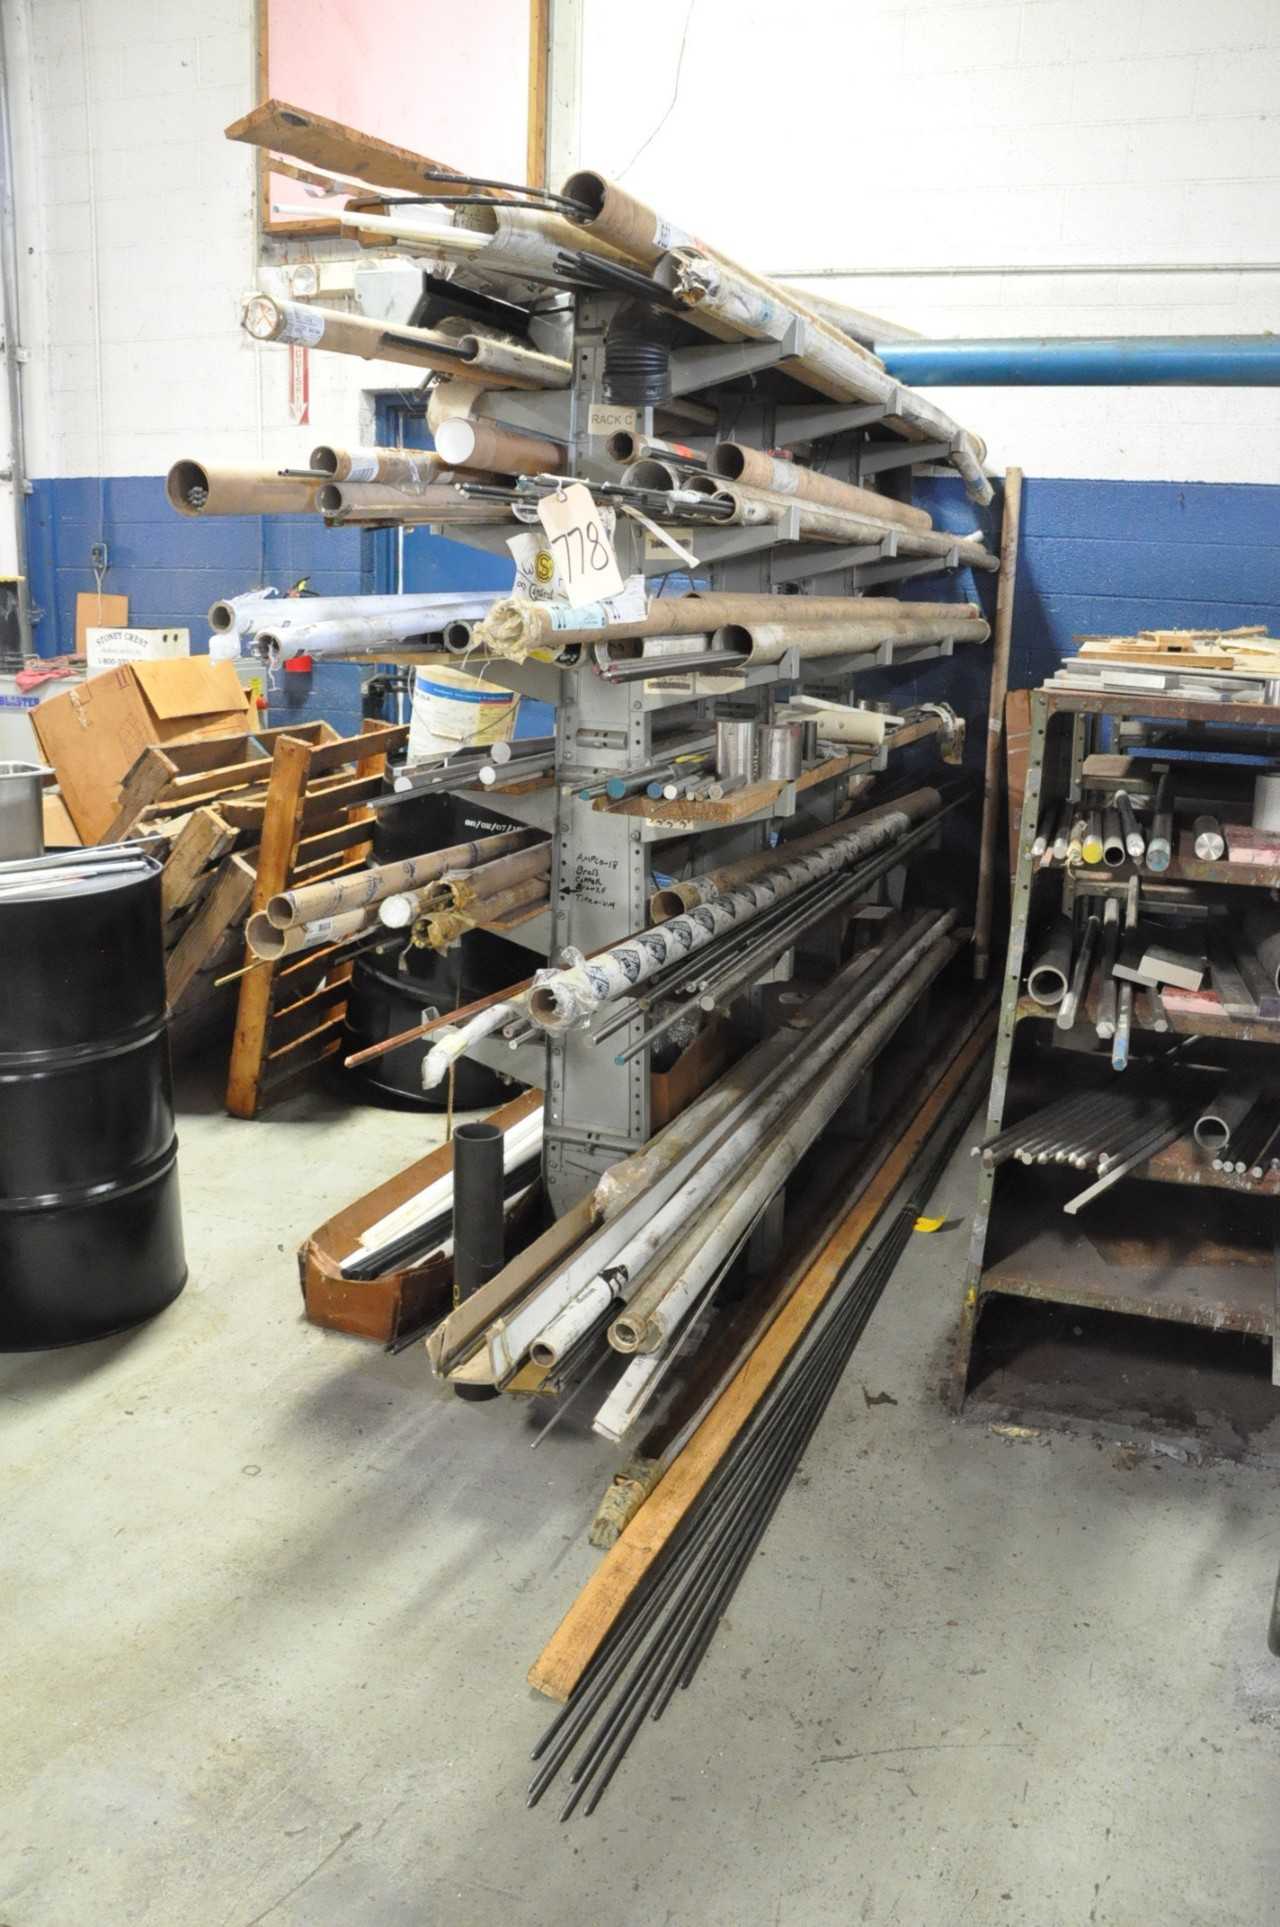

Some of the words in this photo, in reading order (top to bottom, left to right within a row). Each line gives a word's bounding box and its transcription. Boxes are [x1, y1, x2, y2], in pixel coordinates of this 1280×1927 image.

[591, 414, 621, 425] RACK
[624, 414, 633, 425] C
[551, 521, 609, 585] 778
